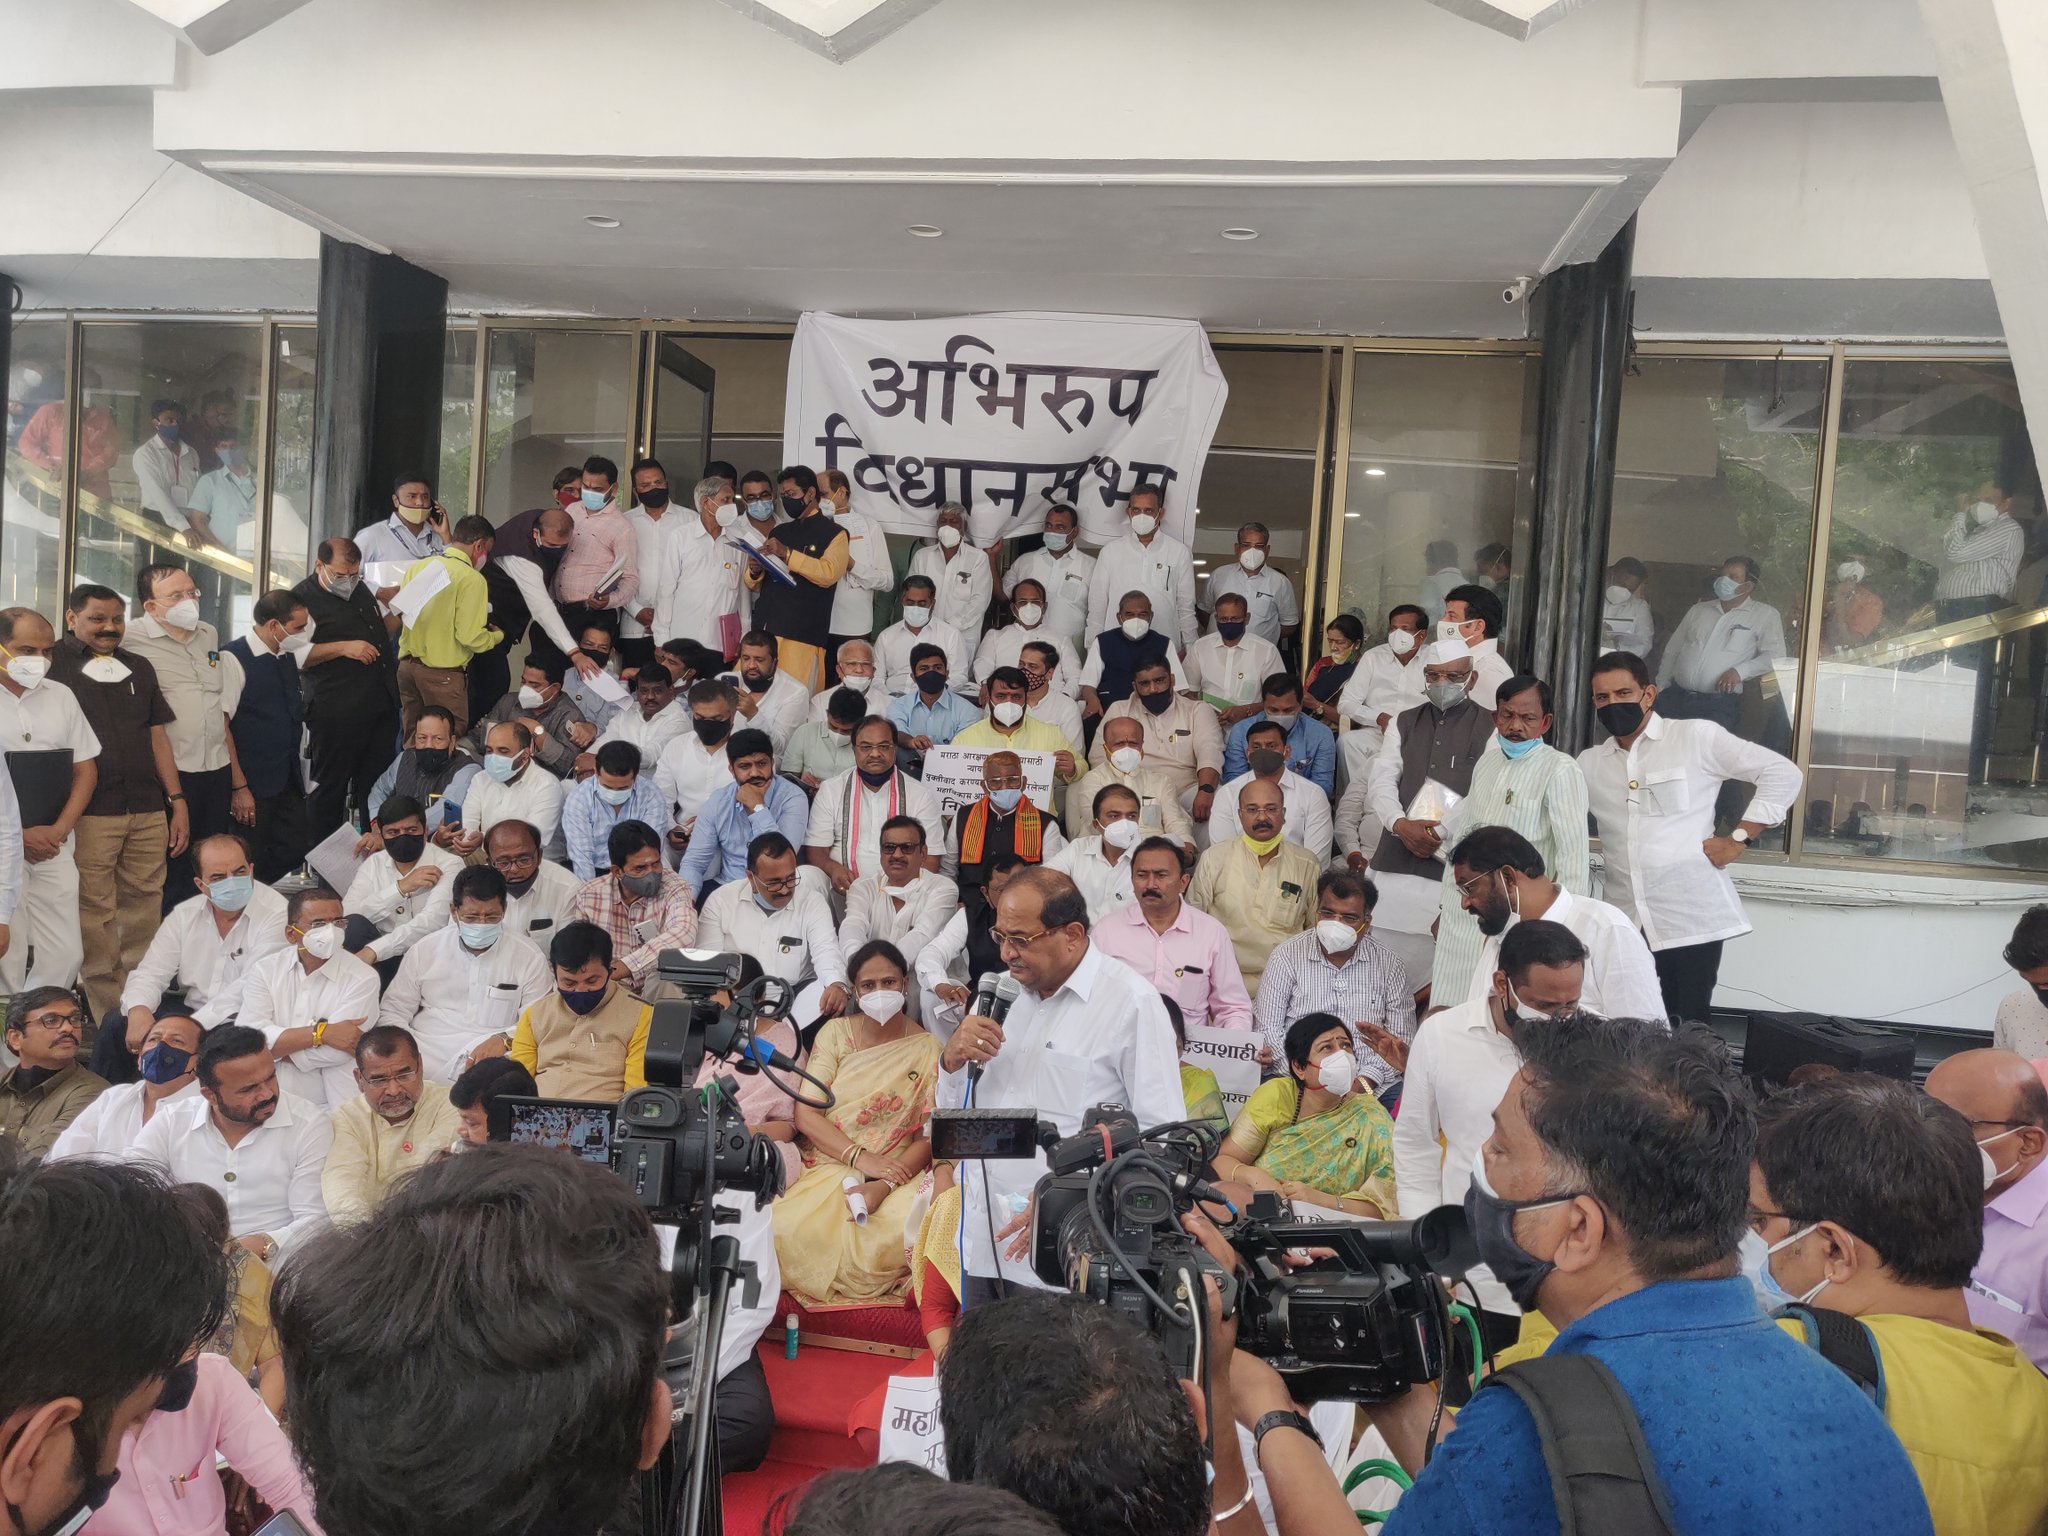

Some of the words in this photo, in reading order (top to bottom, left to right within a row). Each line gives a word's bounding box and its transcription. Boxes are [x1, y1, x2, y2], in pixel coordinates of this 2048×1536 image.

[861, 334, 1160, 434] अभिरुप
[815, 412, 1178, 517] विधानसभा
[940, 751, 959, 760] मराठा
[1020, 755, 1043, 766] यासाठी
[959, 778, 981, 787] करण्य
